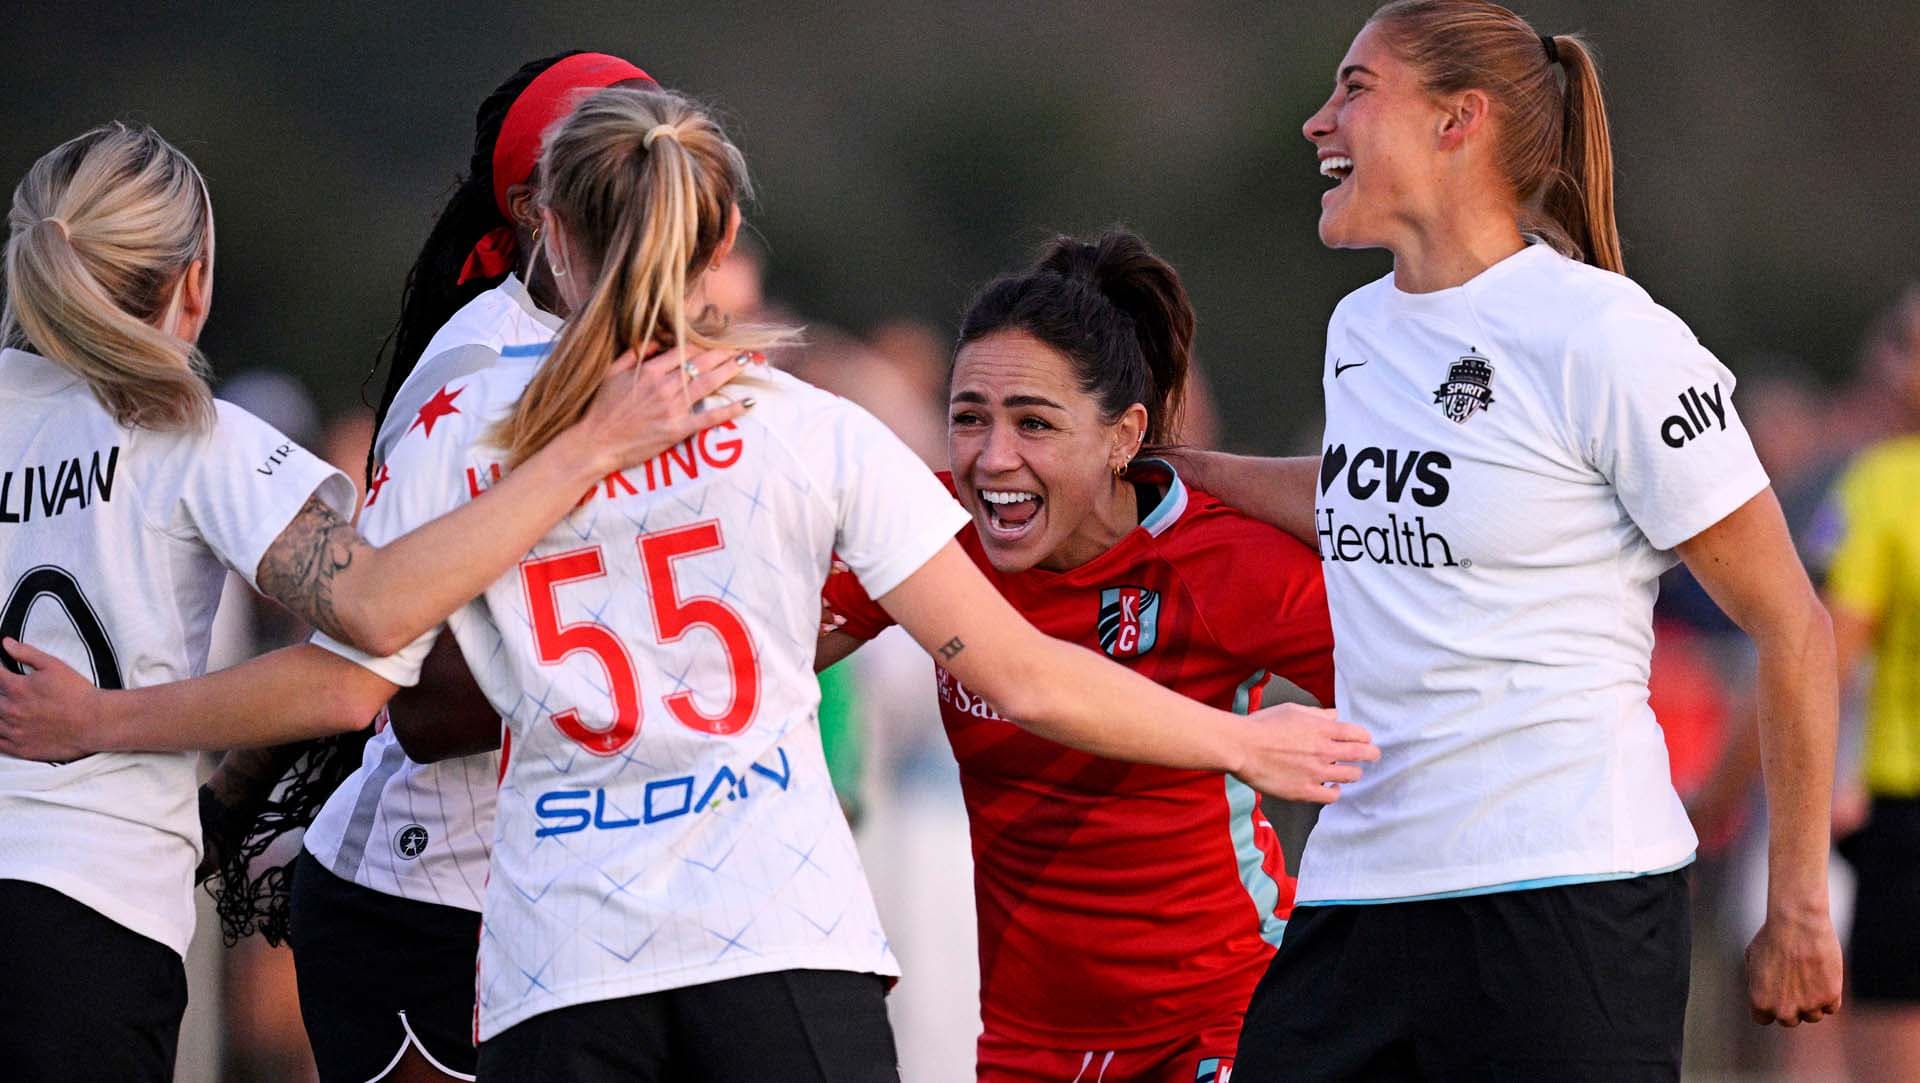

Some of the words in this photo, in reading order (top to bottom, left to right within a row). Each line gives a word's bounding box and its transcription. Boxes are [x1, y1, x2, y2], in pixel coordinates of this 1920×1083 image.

[1446, 382, 1487, 398] SPIRIT
[1660, 382, 1727, 449] ally
[466, 420, 743, 507] HKING
[1347, 444, 1453, 508] CVS
[520, 518, 763, 758] 55
[535, 747, 790, 839] SLOAN
